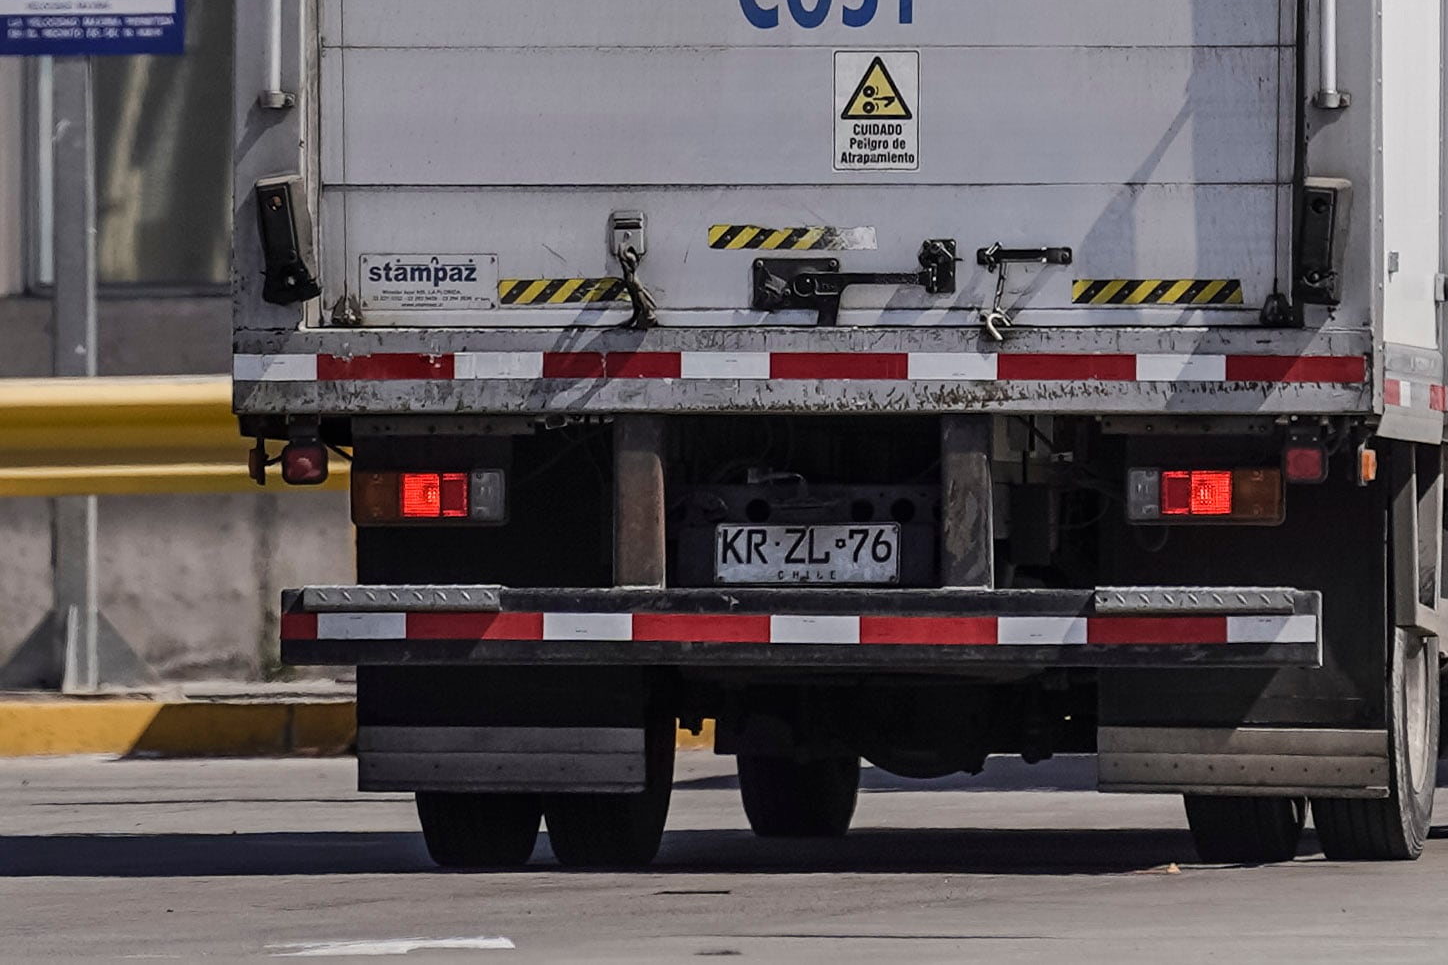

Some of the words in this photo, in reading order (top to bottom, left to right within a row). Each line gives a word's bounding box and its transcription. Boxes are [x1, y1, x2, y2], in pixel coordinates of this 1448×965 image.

[853, 123, 903, 136] CUIDADO
[849, 137, 889, 151] Peligro
[892, 137, 906, 150] de
[840, 151, 915, 165] Atrapamiento
[369, 261, 477, 288] stampaz
